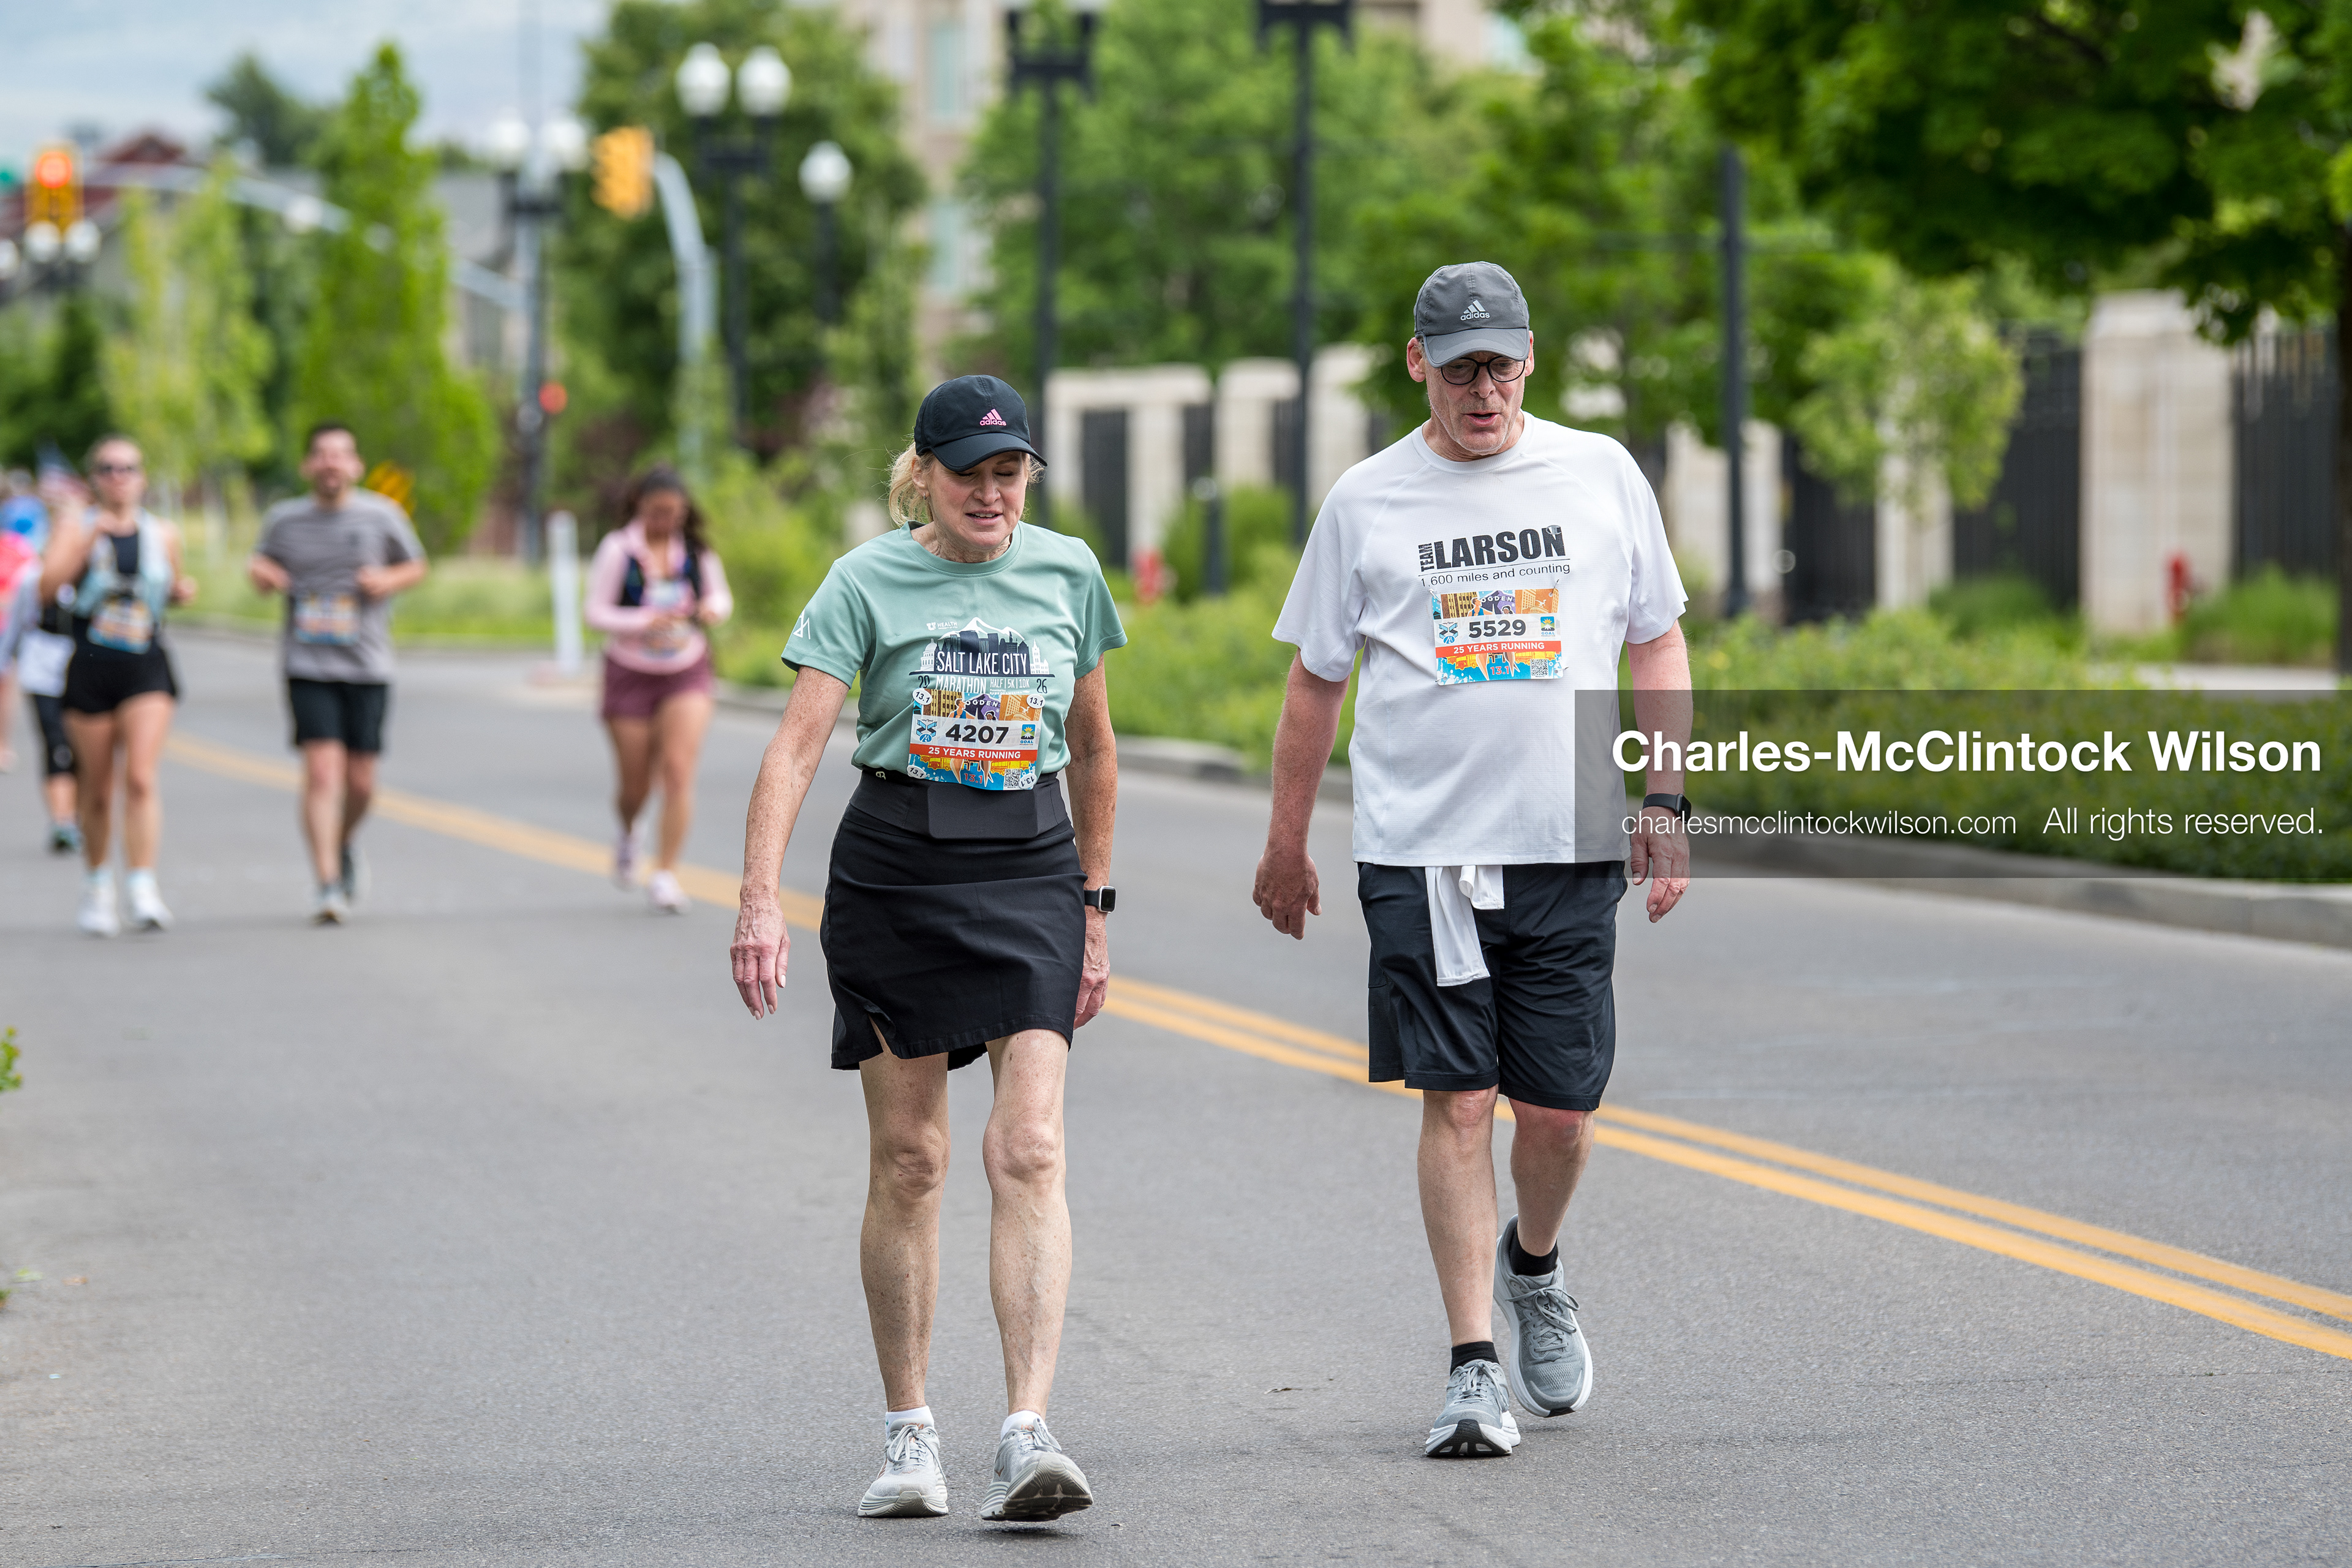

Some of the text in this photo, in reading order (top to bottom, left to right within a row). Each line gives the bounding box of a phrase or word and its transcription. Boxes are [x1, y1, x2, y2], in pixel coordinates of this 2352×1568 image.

[1460, 311, 1490, 320] adidas
[1419, 527, 1566, 572] TEAM LARSON
[1457, 572, 1489, 582] miles
[1493, 568, 1515, 579] and
[1519, 564, 1570, 576] counting
[1468, 619, 1526, 638] 5529
[1466, 644, 1499, 652] YEARS
[937, 651, 1027, 675] SALT LAKE CITY
[1490, 666, 1510, 675] 13.1
[918, 675, 930, 688] 20
[935, 675, 987, 693] MARATHON
[990, 678, 1030, 688] HALF 5K 10K
[1036, 678, 1048, 694] 26
[916, 692, 930, 703] 13.1
[1030, 697, 1044, 706] 13.1
[945, 724, 1009, 744] 4207
[943, 748, 976, 758] YEARS
[978, 750, 1021, 759] RUNNING
[910, 767, 924, 778] 13.1
[963, 773, 983, 784] 13.1
[1020, 776, 1035, 787] 13.1
